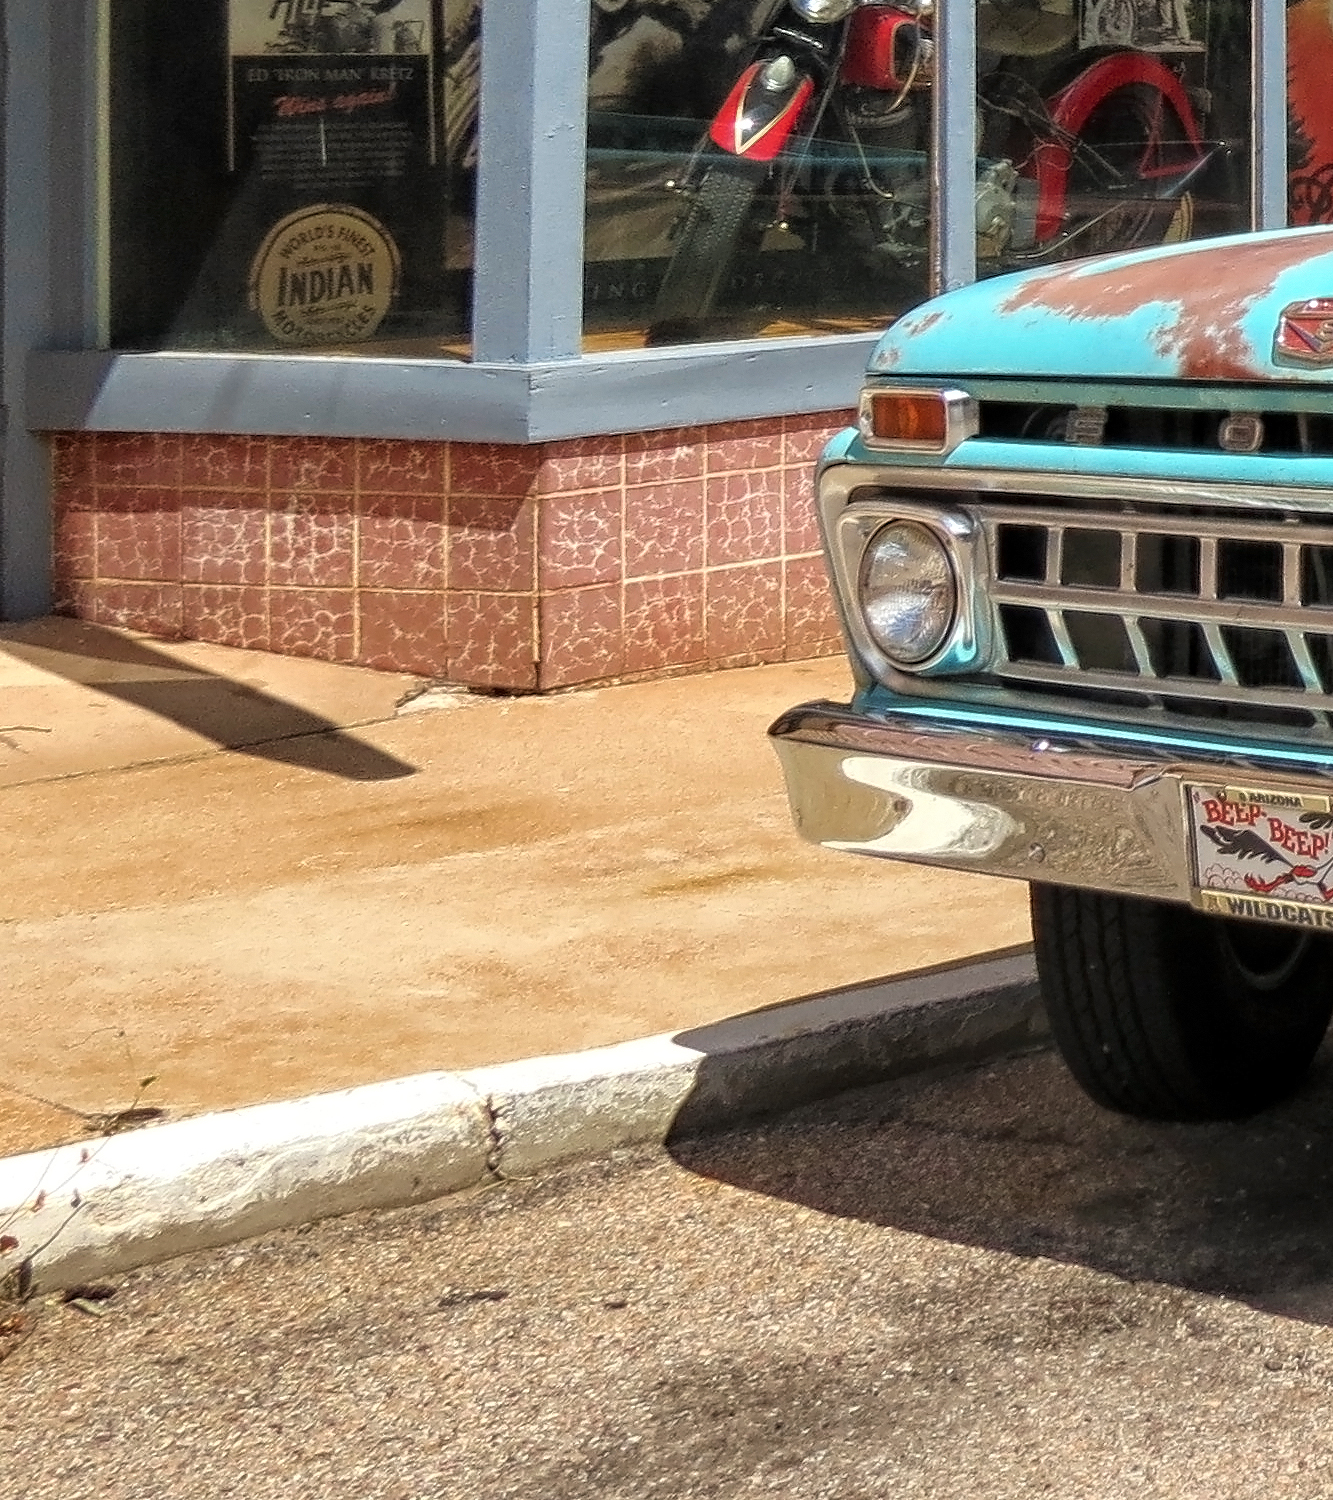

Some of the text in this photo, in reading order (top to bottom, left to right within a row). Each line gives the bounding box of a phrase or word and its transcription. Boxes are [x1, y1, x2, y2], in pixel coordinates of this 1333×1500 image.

[279, 224, 377, 259] WORLD'S FINEST
[277, 262, 374, 307] INDIAN
[1249, 792, 1301, 807] ARIZONA
